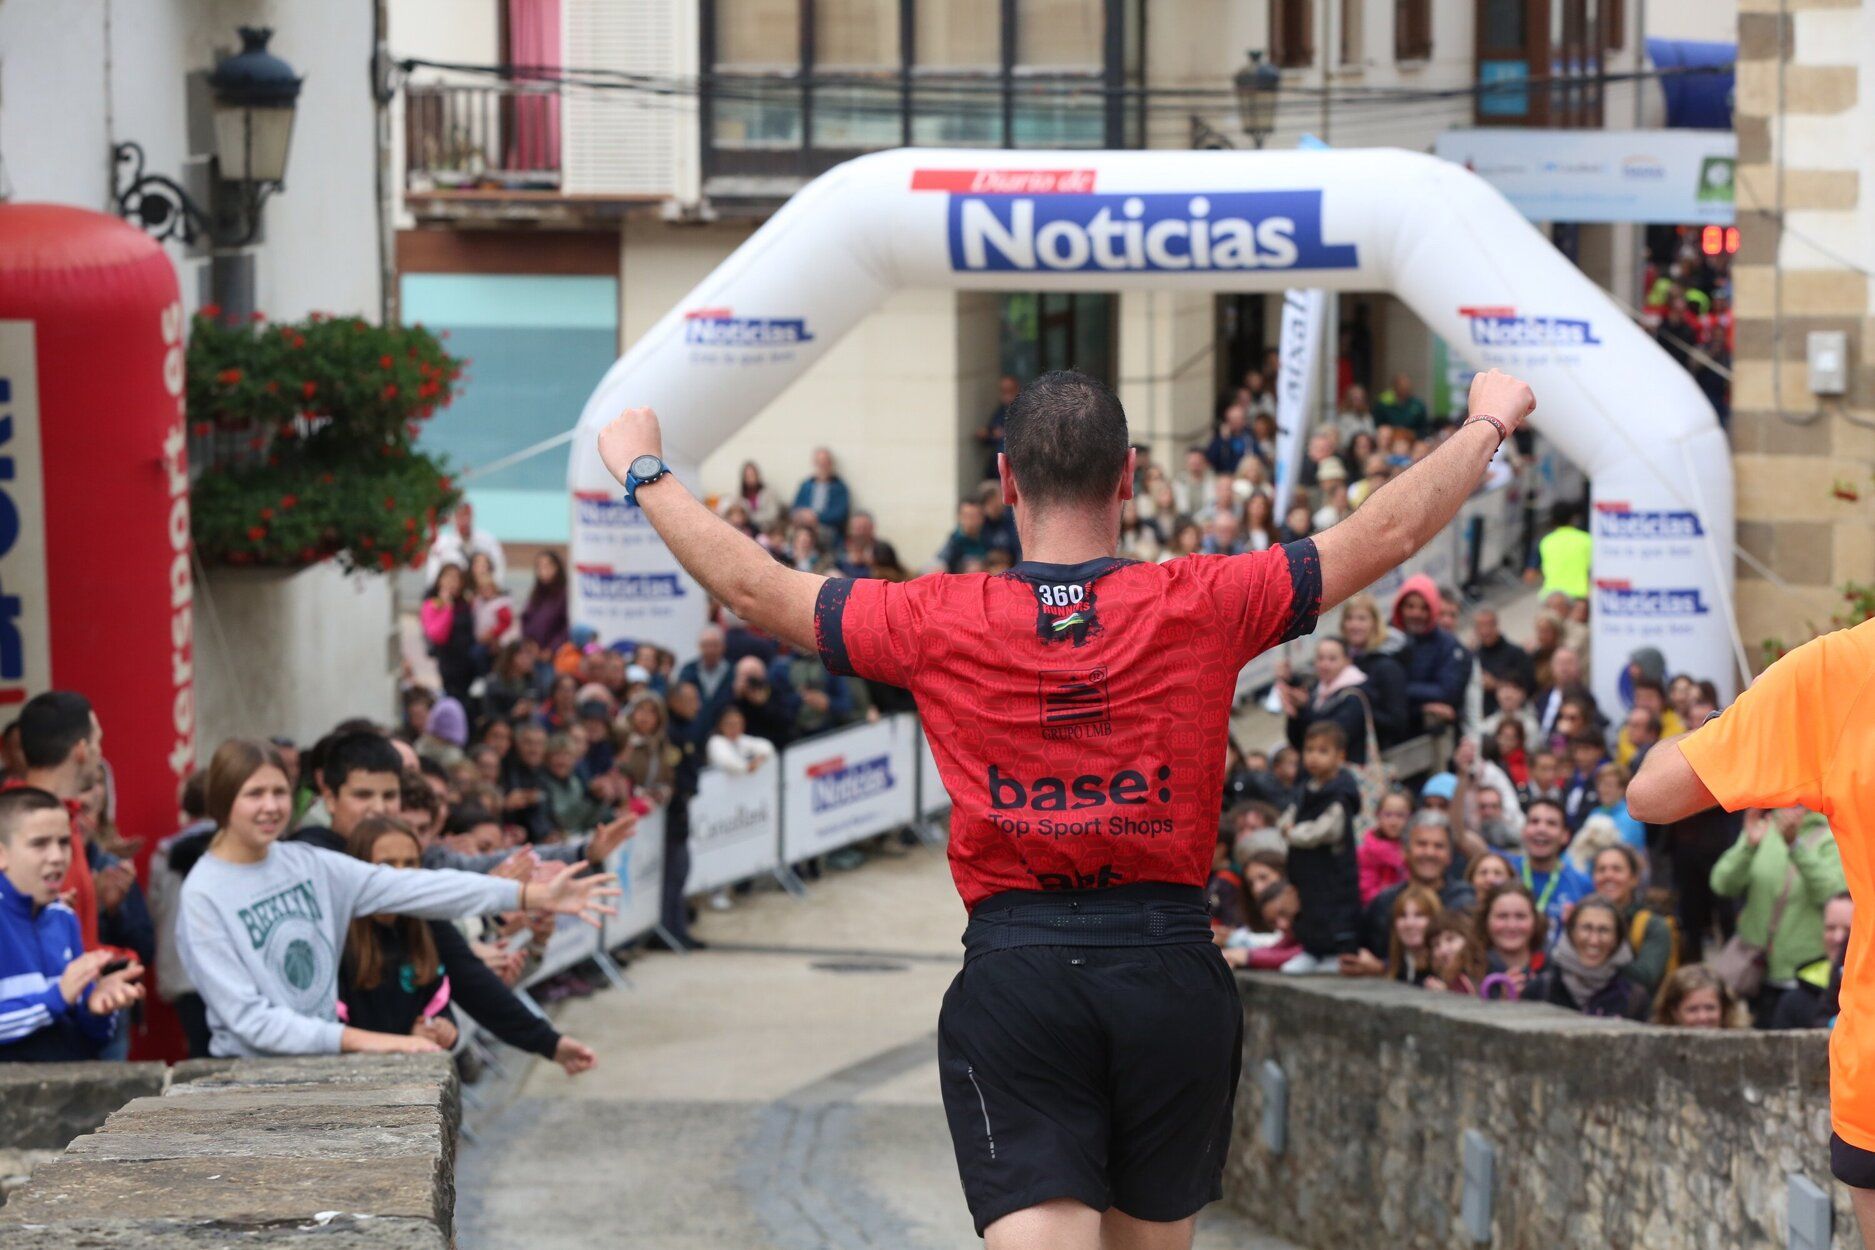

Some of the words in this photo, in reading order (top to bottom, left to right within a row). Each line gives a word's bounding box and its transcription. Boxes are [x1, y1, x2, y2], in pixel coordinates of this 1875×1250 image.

[970, 171, 1056, 192] Diario
[1057, 169, 1092, 192] de
[961, 197, 1298, 270] Noticias
[690, 318, 798, 343] Noticias
[1474, 318, 1584, 344] Noticias
[1601, 511, 1695, 537] Noticias
[163, 299, 194, 790] tersport.es
[1039, 584, 1083, 607] 360
[1601, 589, 1697, 615] Noticias
[1042, 725, 1083, 740] GRUPO
[1086, 721, 1112, 738] LMB
[988, 764, 1171, 811] base:
[989, 814, 1030, 839] Top
[1037, 819, 1100, 839] Sport
[1108, 816, 1174, 838] Shops
